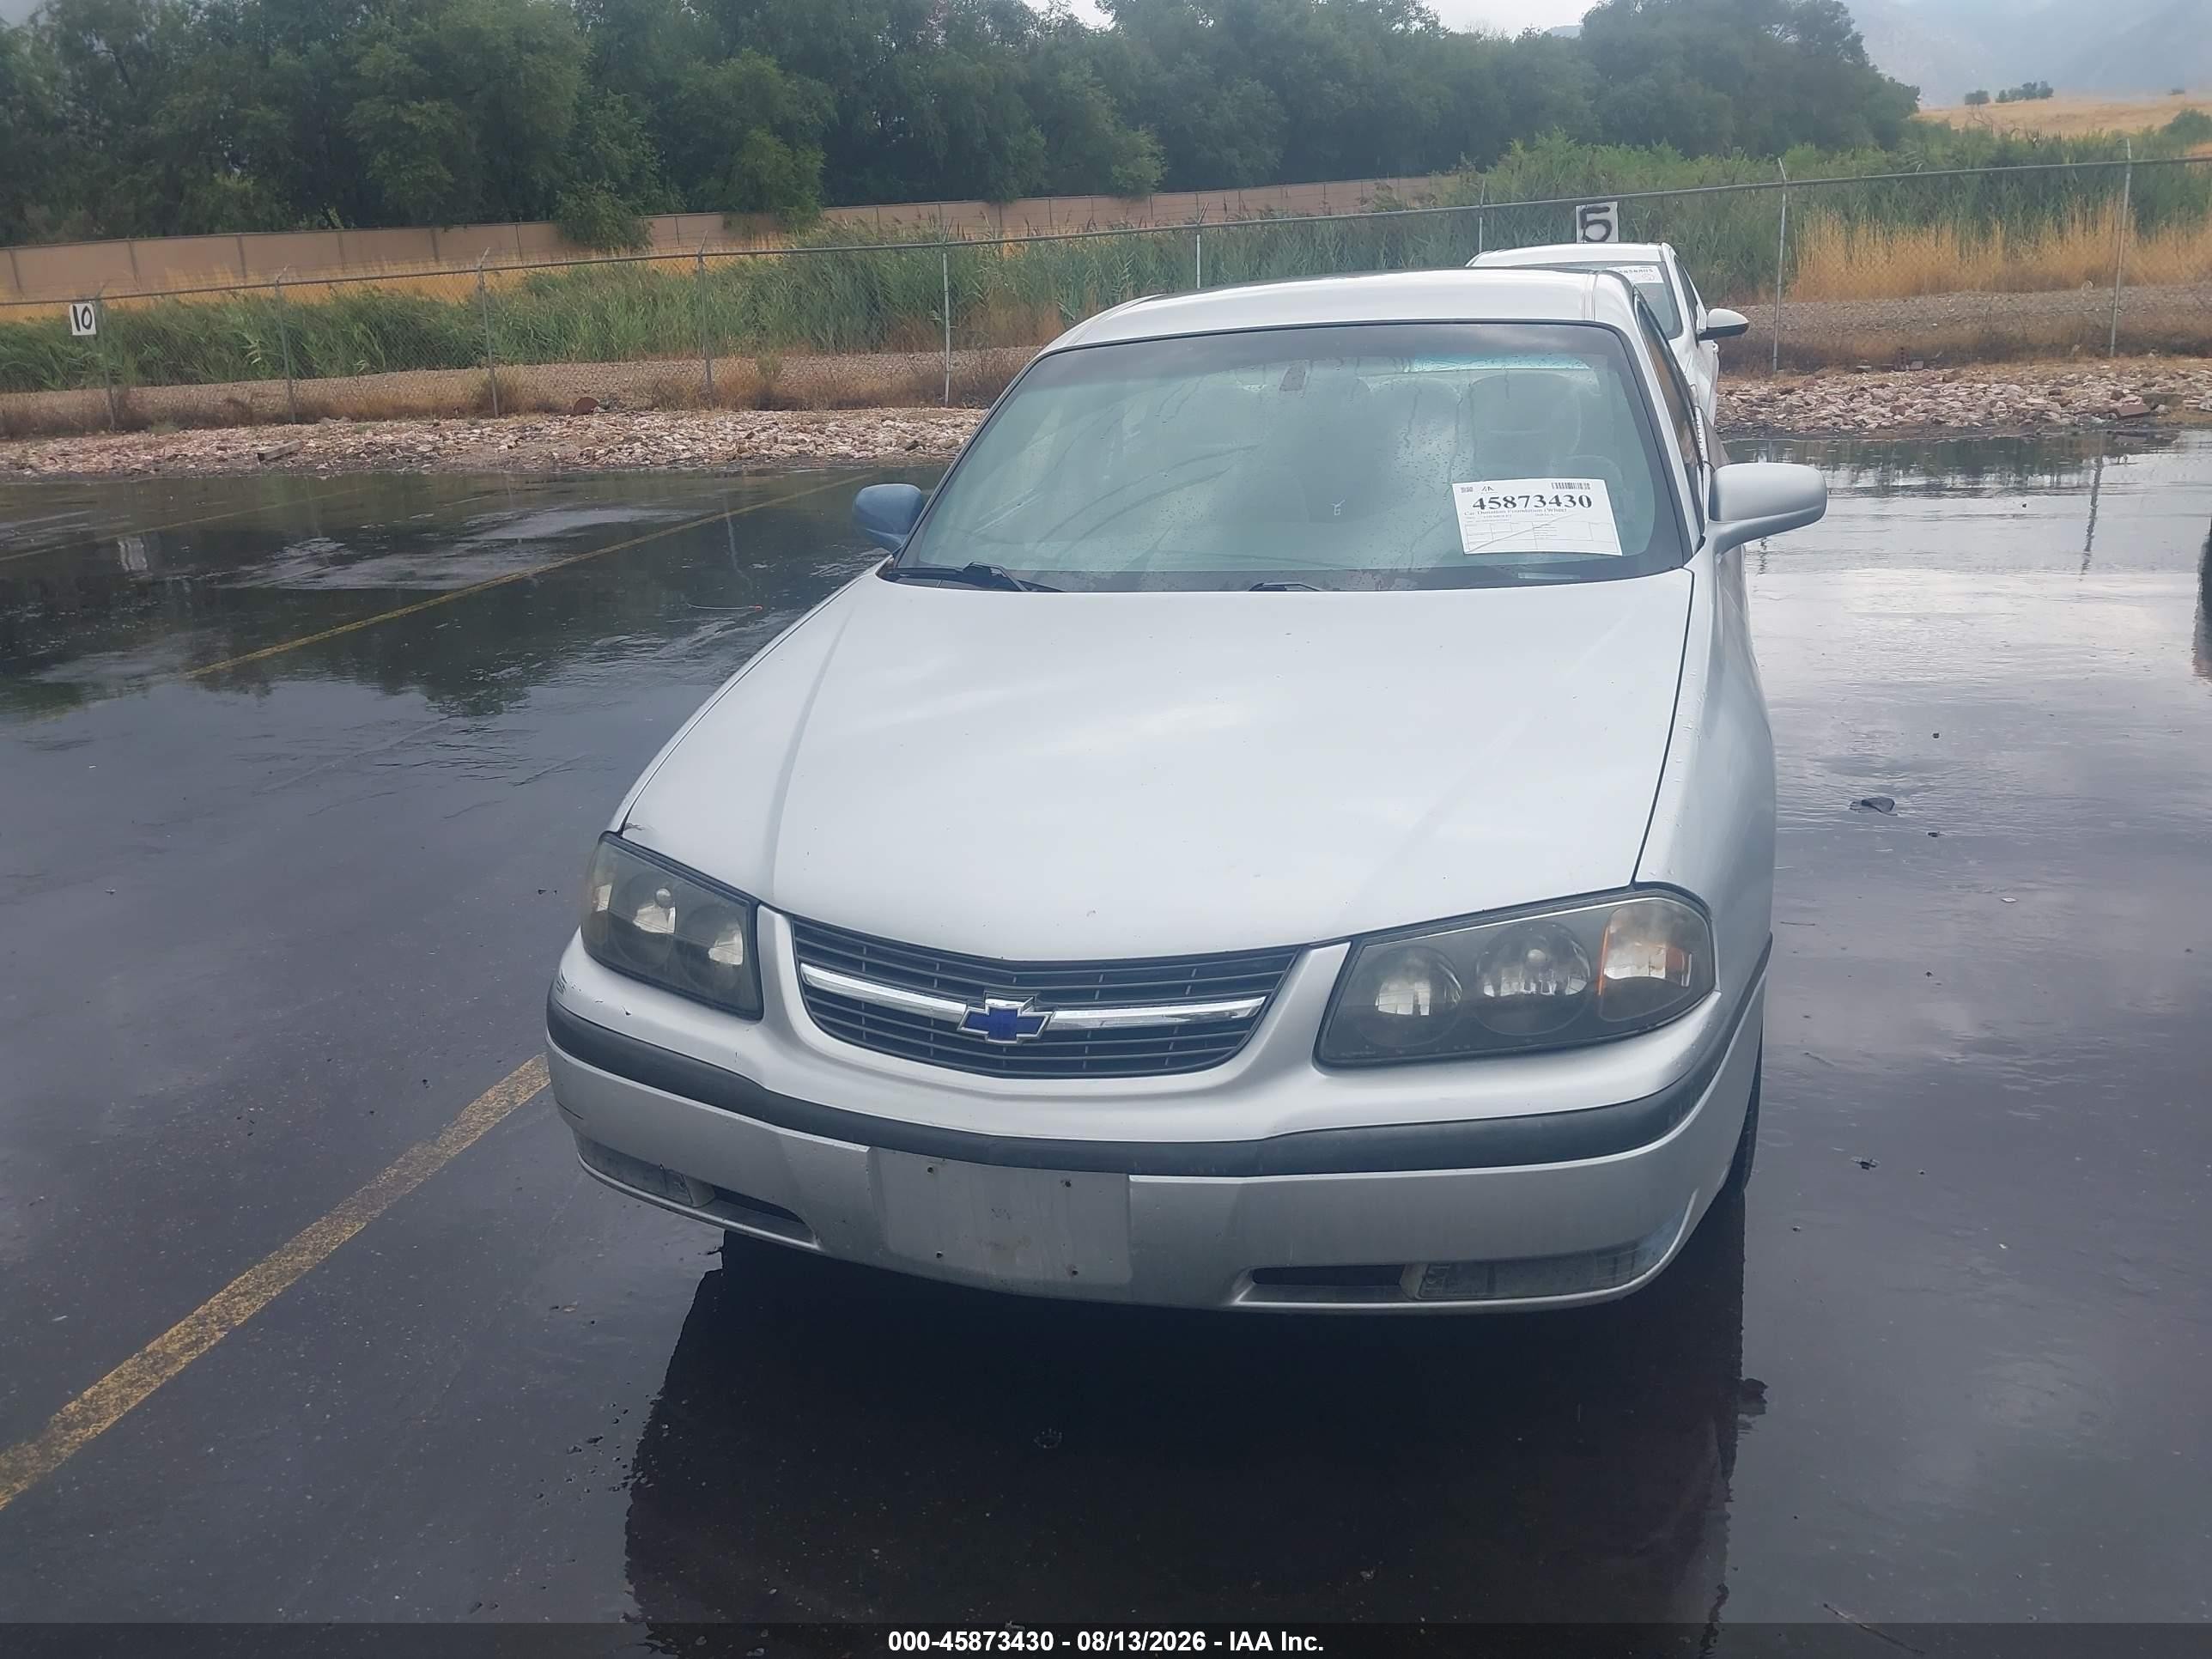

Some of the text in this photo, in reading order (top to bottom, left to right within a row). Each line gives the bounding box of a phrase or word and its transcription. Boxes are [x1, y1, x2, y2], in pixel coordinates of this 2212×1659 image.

[1580, 206, 1612, 242] 5
[72, 305, 93, 331] 10
[1473, 495, 1592, 510] 45873430
